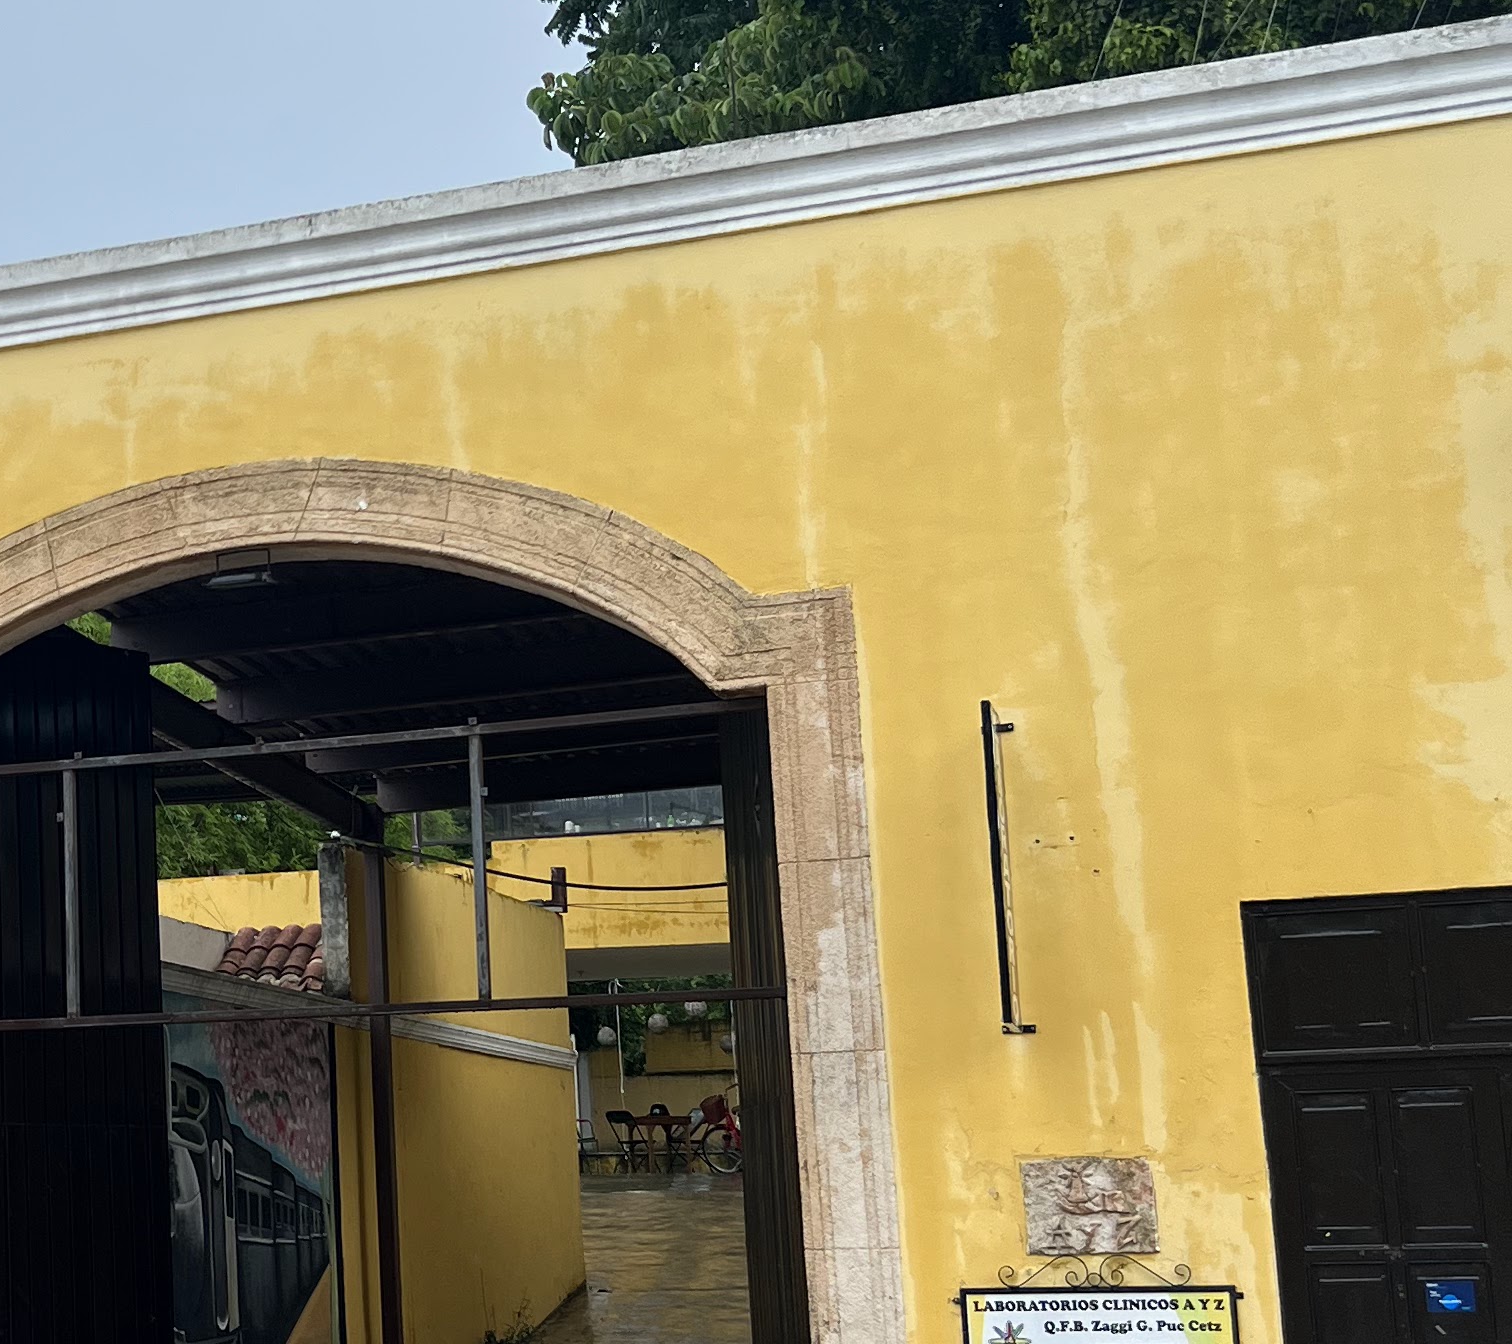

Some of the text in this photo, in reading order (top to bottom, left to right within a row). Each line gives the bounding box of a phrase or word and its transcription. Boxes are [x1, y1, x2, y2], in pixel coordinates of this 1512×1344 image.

[973, 1299, 1225, 1312] LABORATORIOS CLINICOS A Y Z
[1044, 1320, 1222, 1334] Q.F.B. Zaggi G. Puc Cetz
